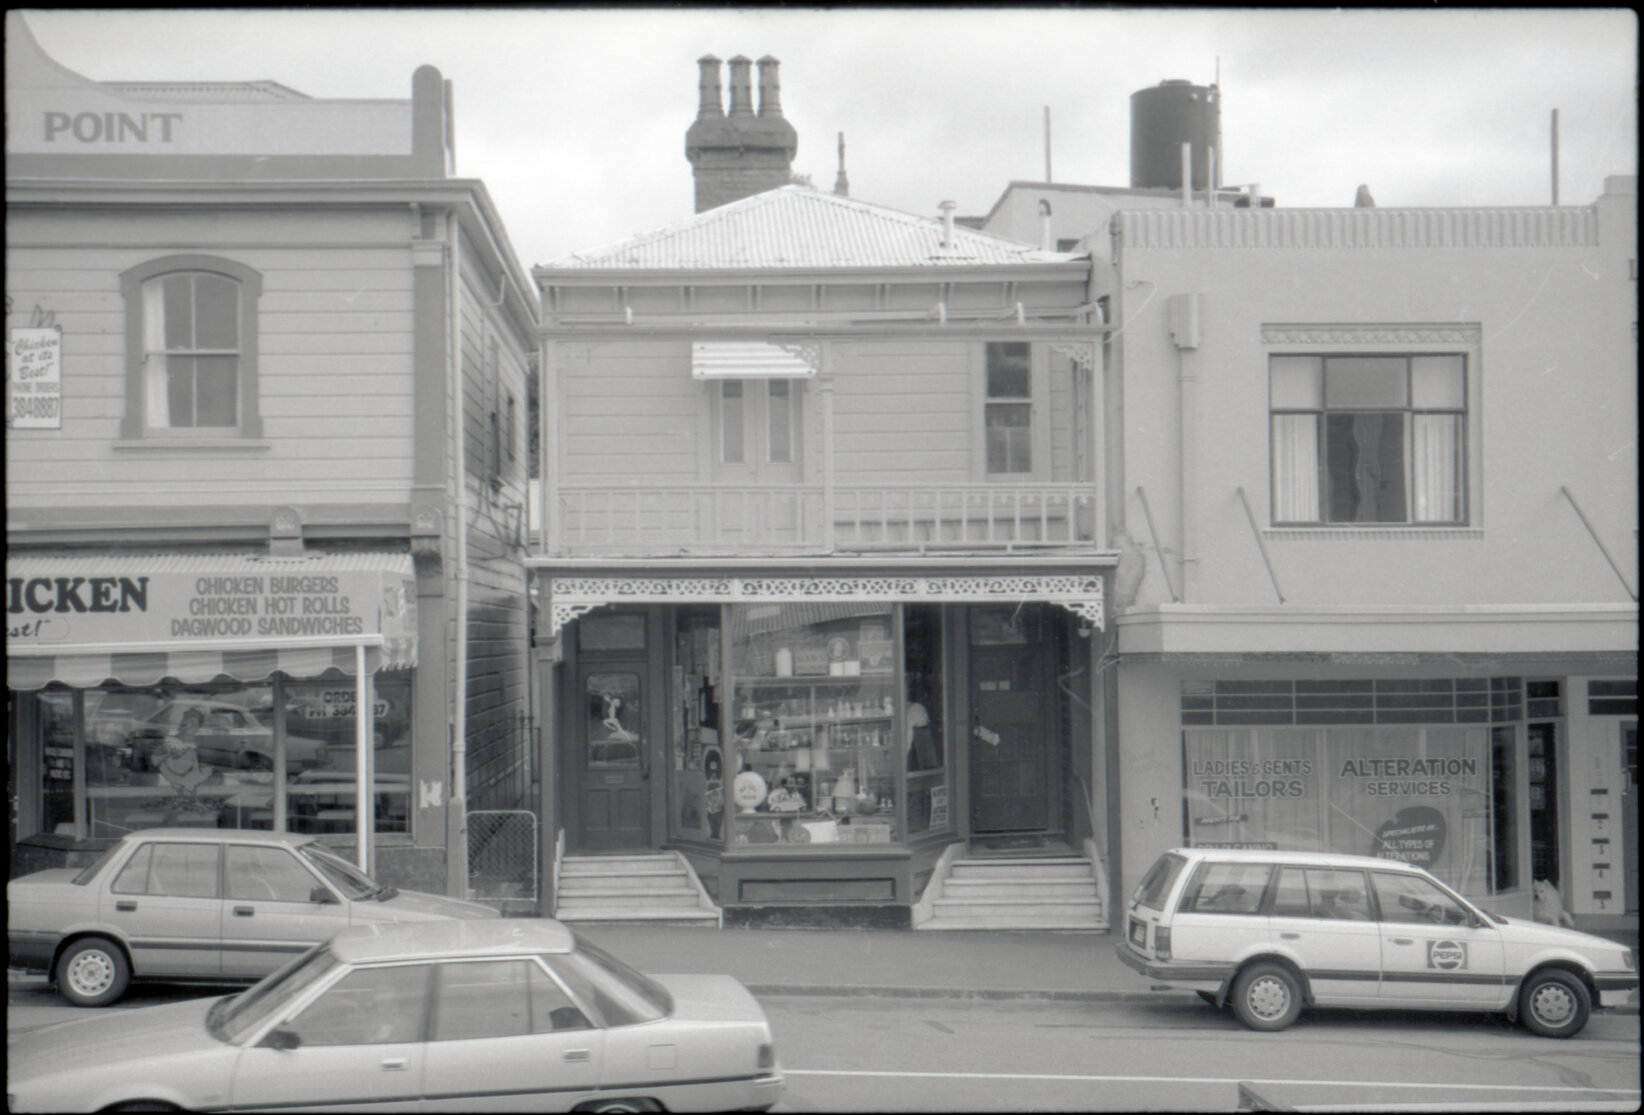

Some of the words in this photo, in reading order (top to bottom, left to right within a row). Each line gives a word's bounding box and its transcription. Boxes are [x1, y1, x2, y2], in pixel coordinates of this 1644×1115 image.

[42, 111, 183, 143] POINT
[14, 337, 58, 356] Chicken
[13, 397, 59, 419] 3848887
[196, 577, 263, 595] CHICKEN
[270, 576, 338, 594] BURGERS
[189, 597, 257, 616] CHICKEN
[264, 597, 297, 615] HOT
[303, 596, 350, 614] ROLLS
[171, 618, 252, 636] DAGWOOD
[257, 616, 363, 635] SANDWICHES
[1193, 760, 1249, 775] LADIES
[1251, 763, 1260, 775] &
[1263, 760, 1312, 774] GENTS
[1341, 759, 1476, 777] ALTERATION
[1202, 780, 1303, 798] TAILORS
[1367, 781, 1451, 795] SERVICES
[1382, 839, 1398, 849] ALL
[1399, 839, 1423, 849] TYPES
[1424, 839, 1435, 849] OF
[1432, 951, 1463, 960] PEPSI
